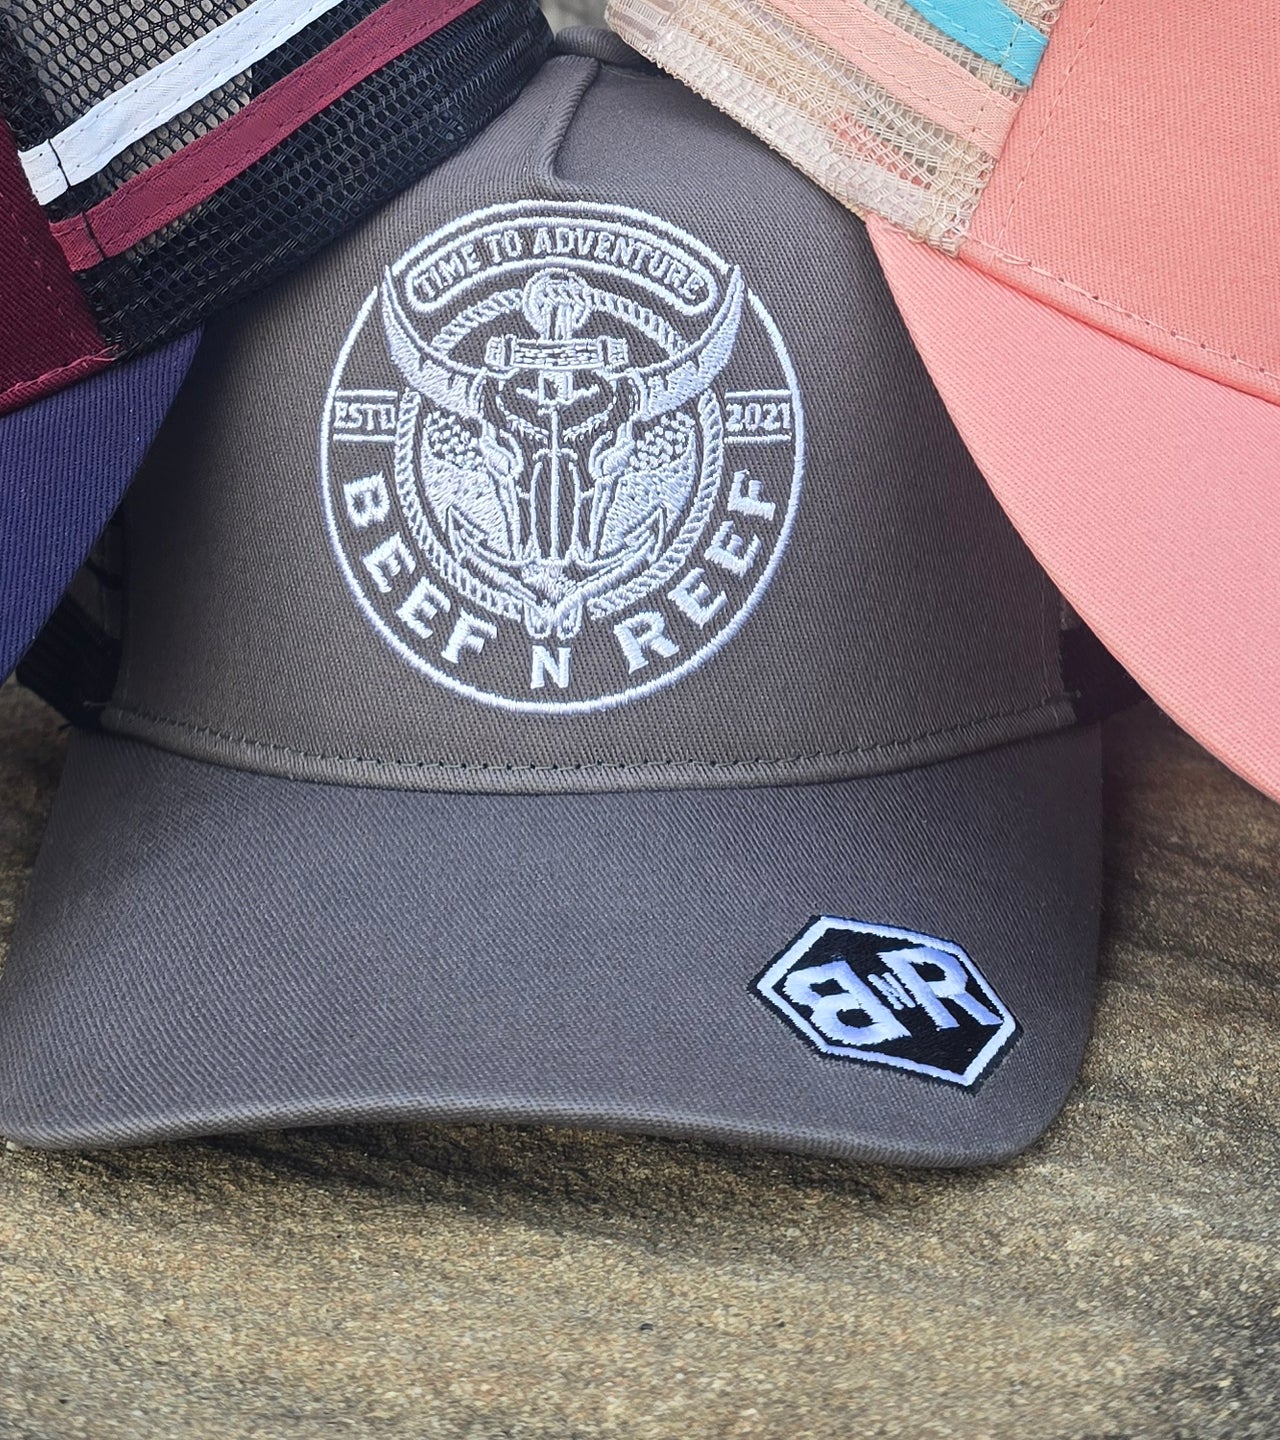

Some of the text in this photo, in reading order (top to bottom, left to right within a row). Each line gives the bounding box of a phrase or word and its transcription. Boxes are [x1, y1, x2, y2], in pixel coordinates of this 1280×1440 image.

[414, 226, 707, 301] TIME TO ADVENTURE
[333, 401, 397, 431] ESTD
[724, 402, 792, 432] 2021
[342, 468, 777, 689] BEEF N REEF
